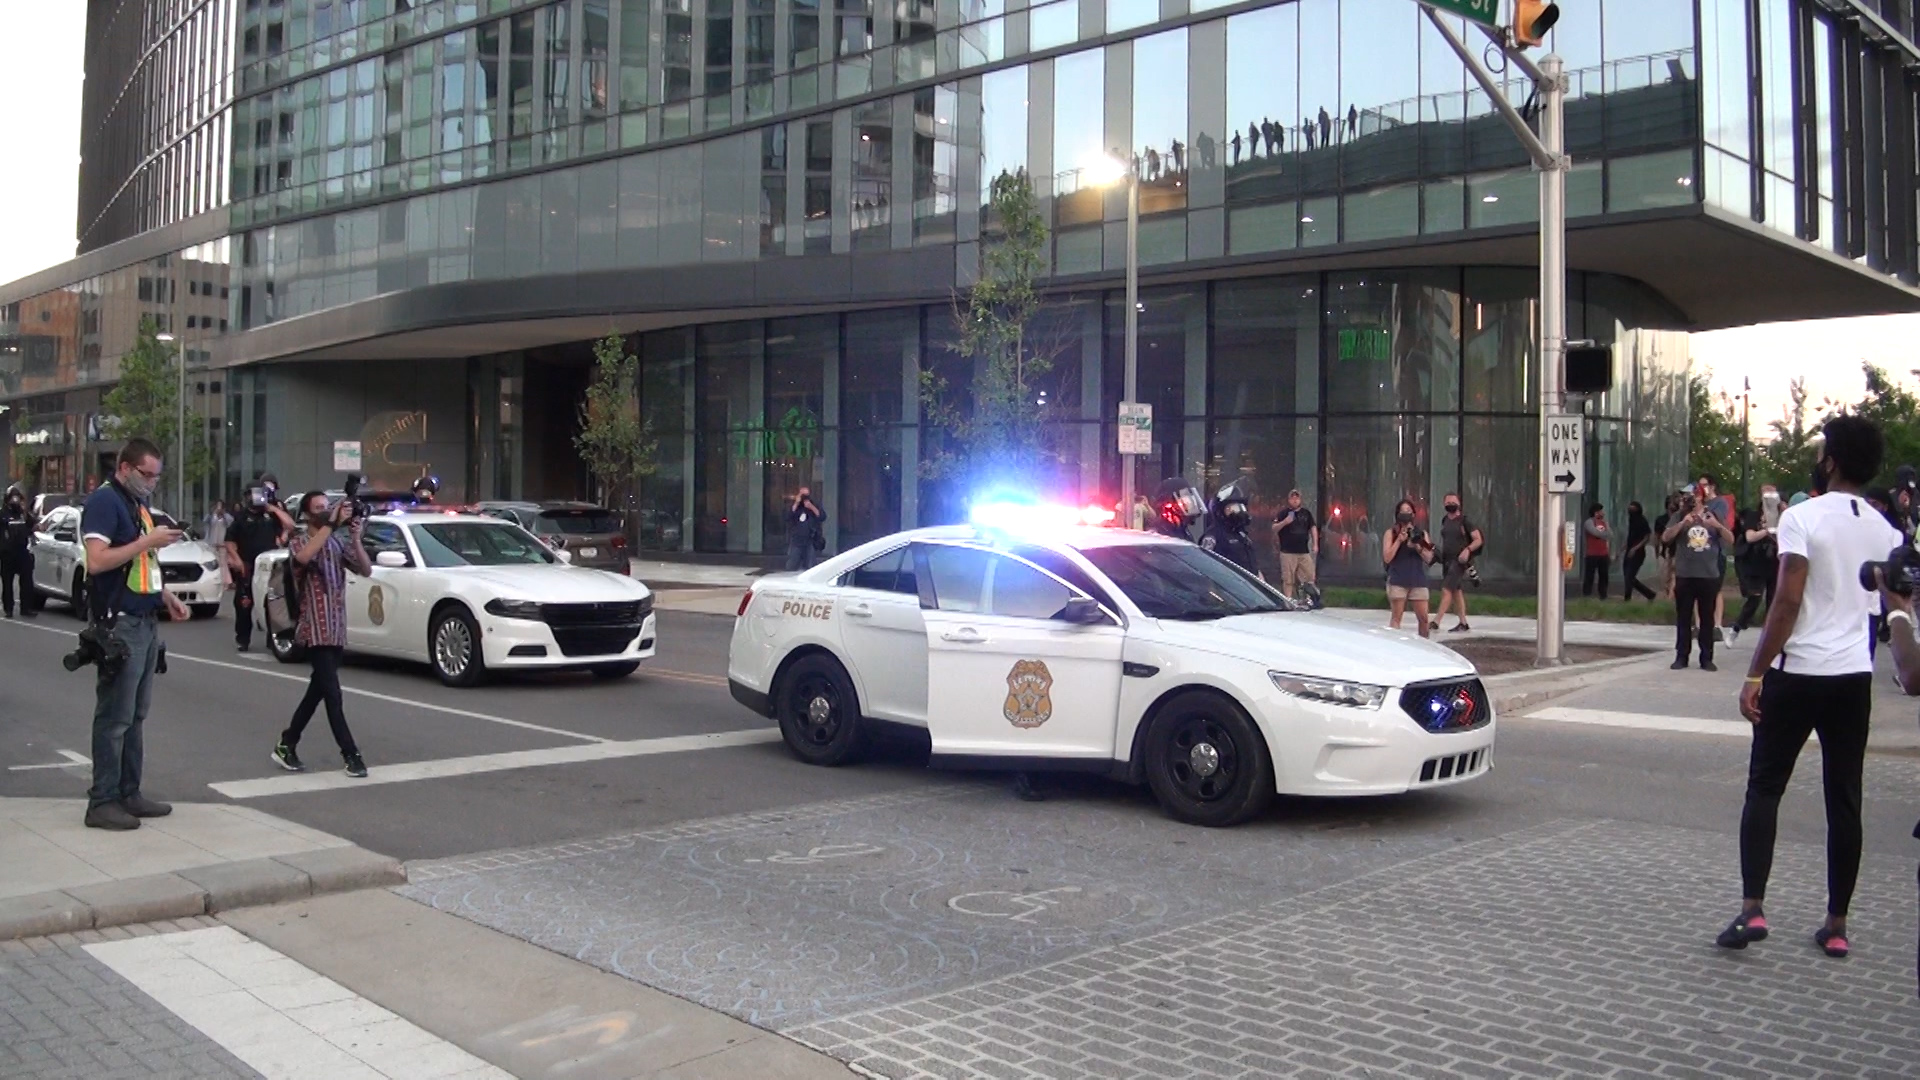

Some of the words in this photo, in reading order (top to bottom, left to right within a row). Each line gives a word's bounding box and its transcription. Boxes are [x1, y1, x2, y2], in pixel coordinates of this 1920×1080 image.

[1551, 423, 1579, 440] ONE
[1551, 448, 1580, 465] WAY
[782, 600, 832, 620] POLICE
